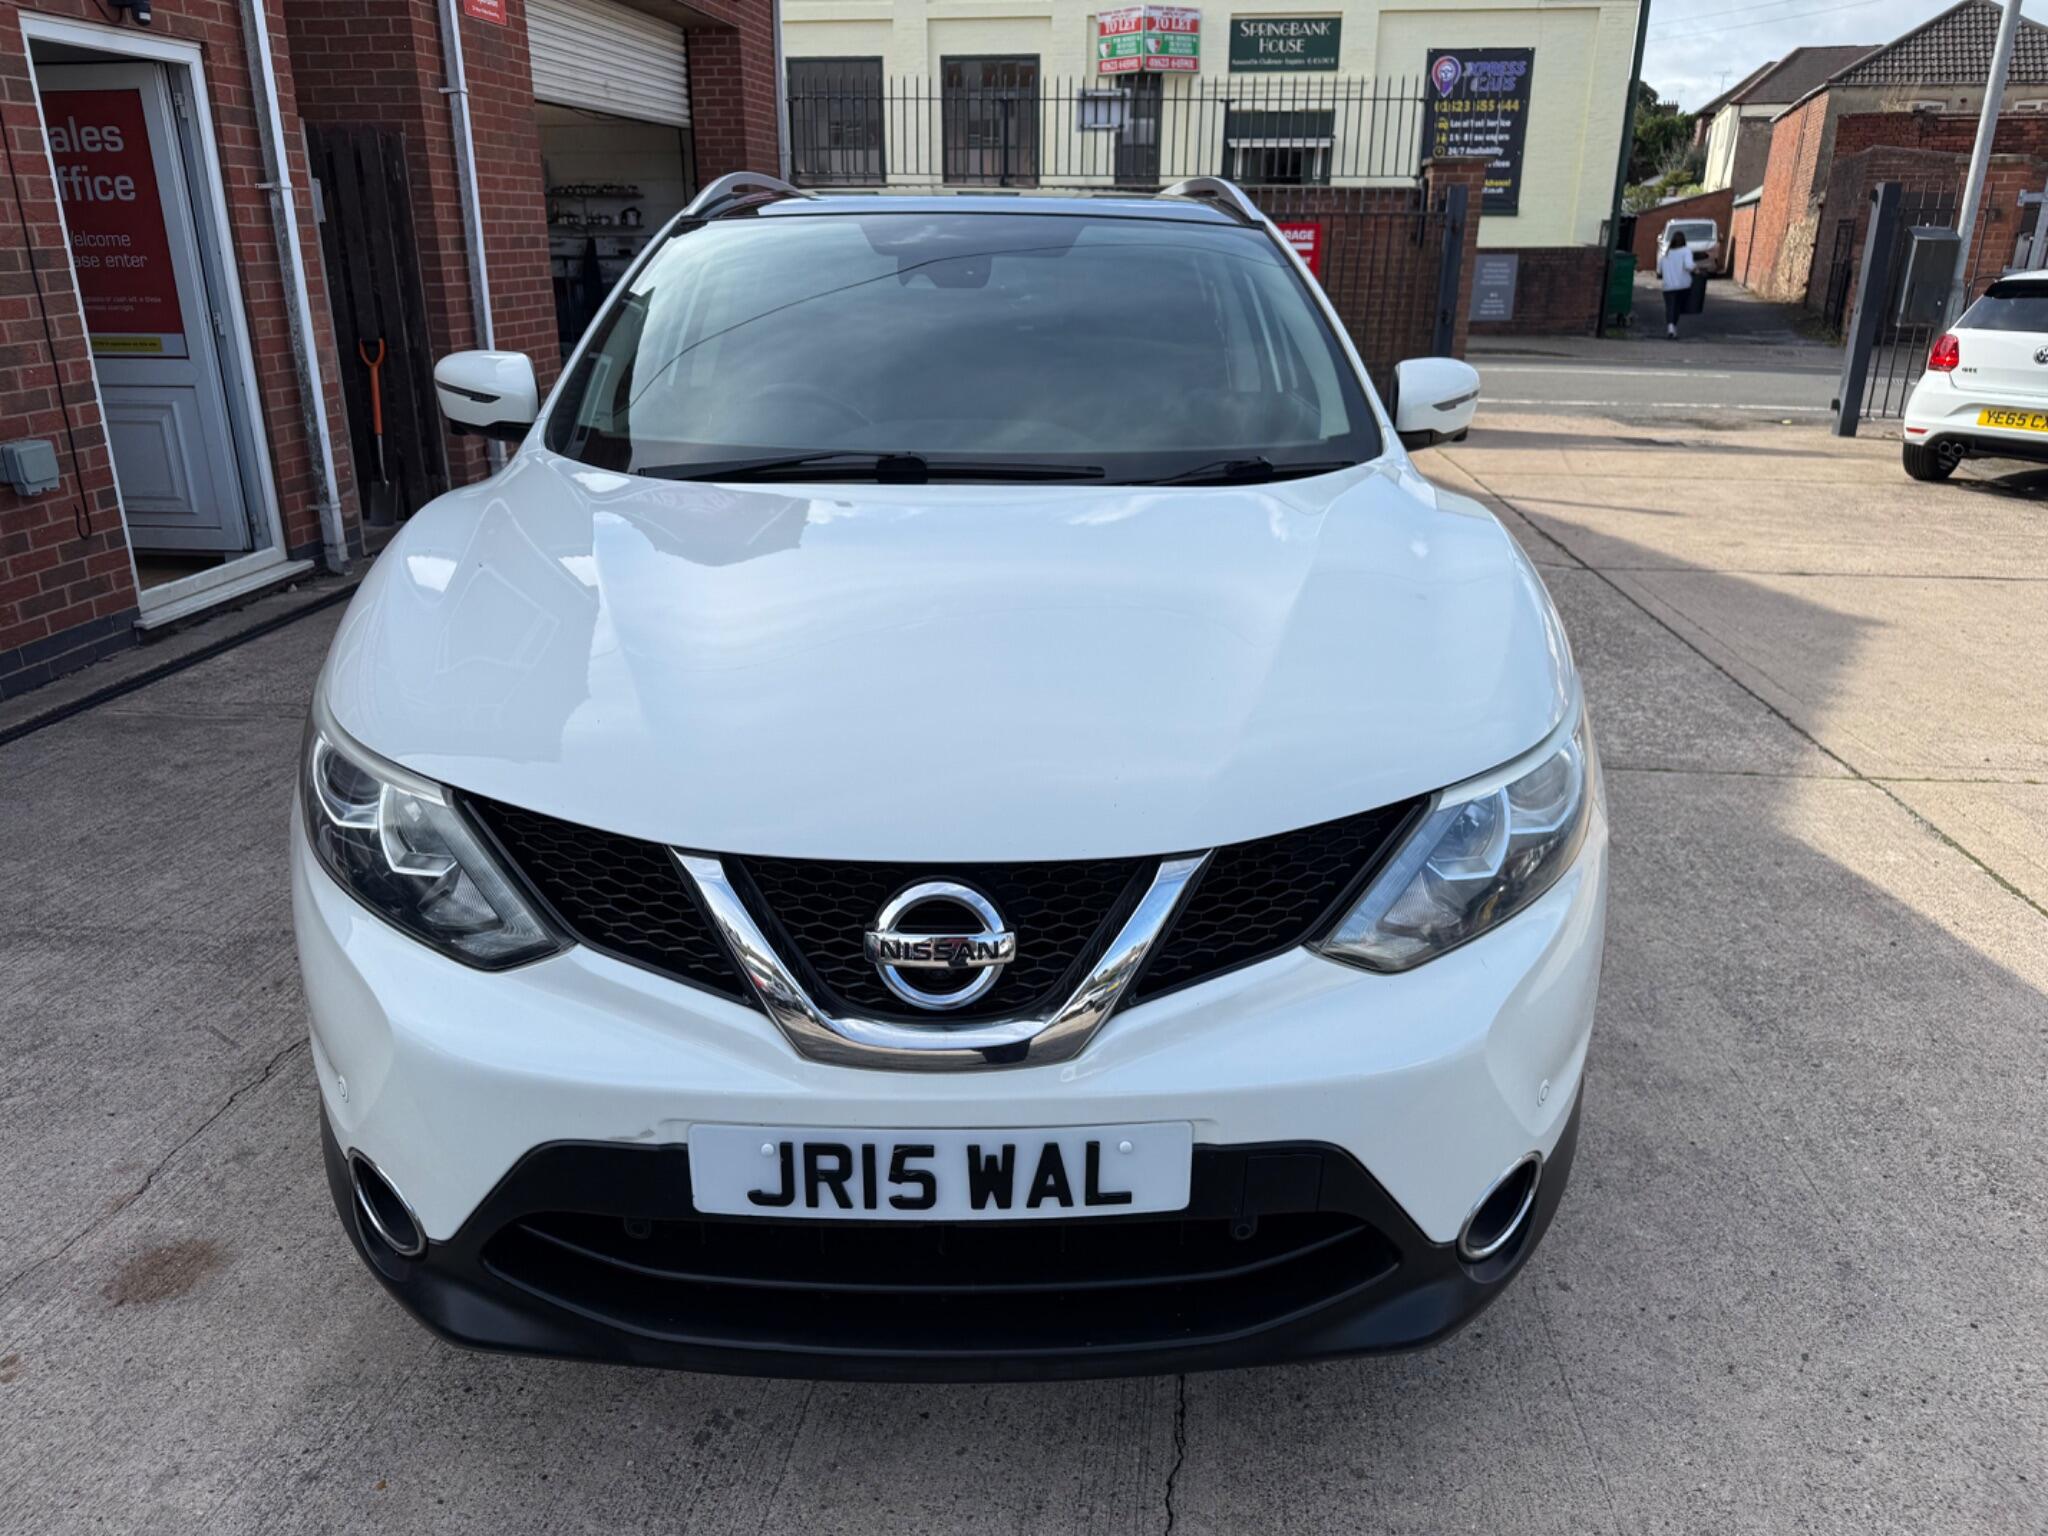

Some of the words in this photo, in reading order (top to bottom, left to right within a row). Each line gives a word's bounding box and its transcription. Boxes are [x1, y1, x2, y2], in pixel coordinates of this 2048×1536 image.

[1240, 21, 1332, 38] SPRINGBANK
[1258, 38, 1305, 53] HOUSE
[49, 116, 125, 152] ales
[57, 164, 137, 202] ffice
[71, 231, 132, 247] elcome
[105, 252, 148, 268] enter
[1986, 410, 2027, 428] YE65
[879, 940, 1000, 961] NISSAN
[746, 1141, 938, 1211] JR15
[966, 1140, 1134, 1211] WAL
